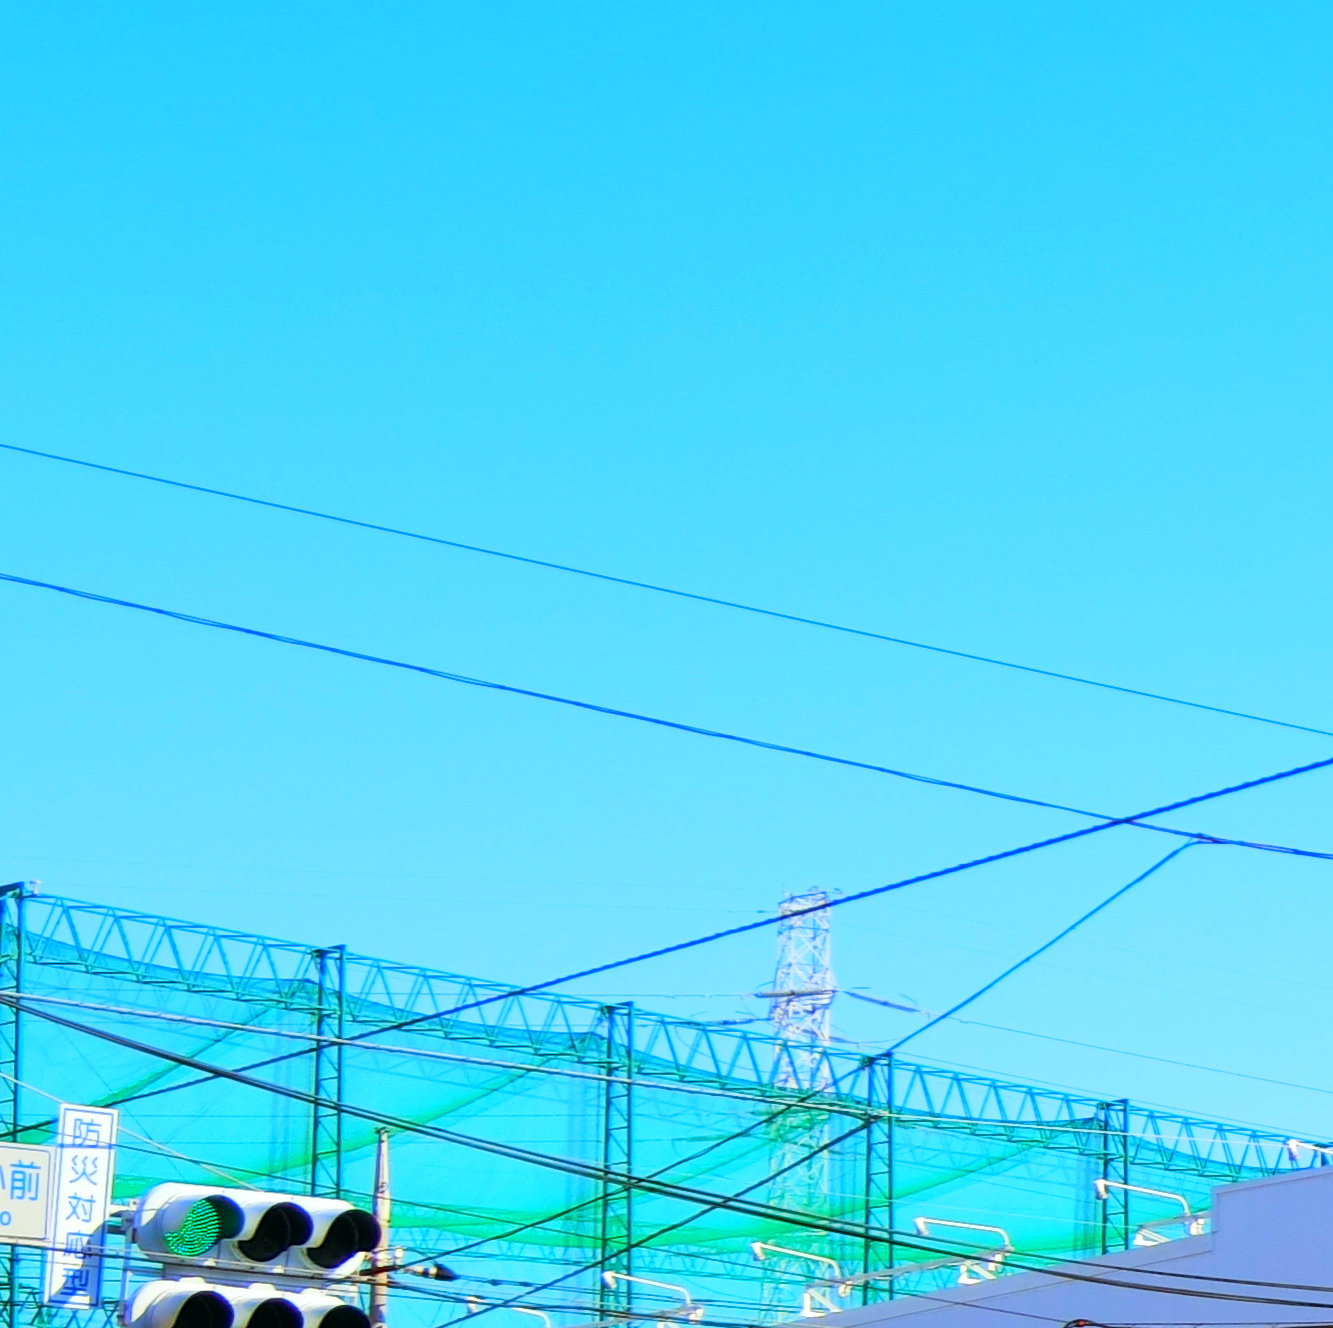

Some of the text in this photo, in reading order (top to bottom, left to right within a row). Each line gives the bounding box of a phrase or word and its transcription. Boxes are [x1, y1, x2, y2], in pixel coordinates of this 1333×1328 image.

[62, 1118, 103, 1297] 防災対応型
